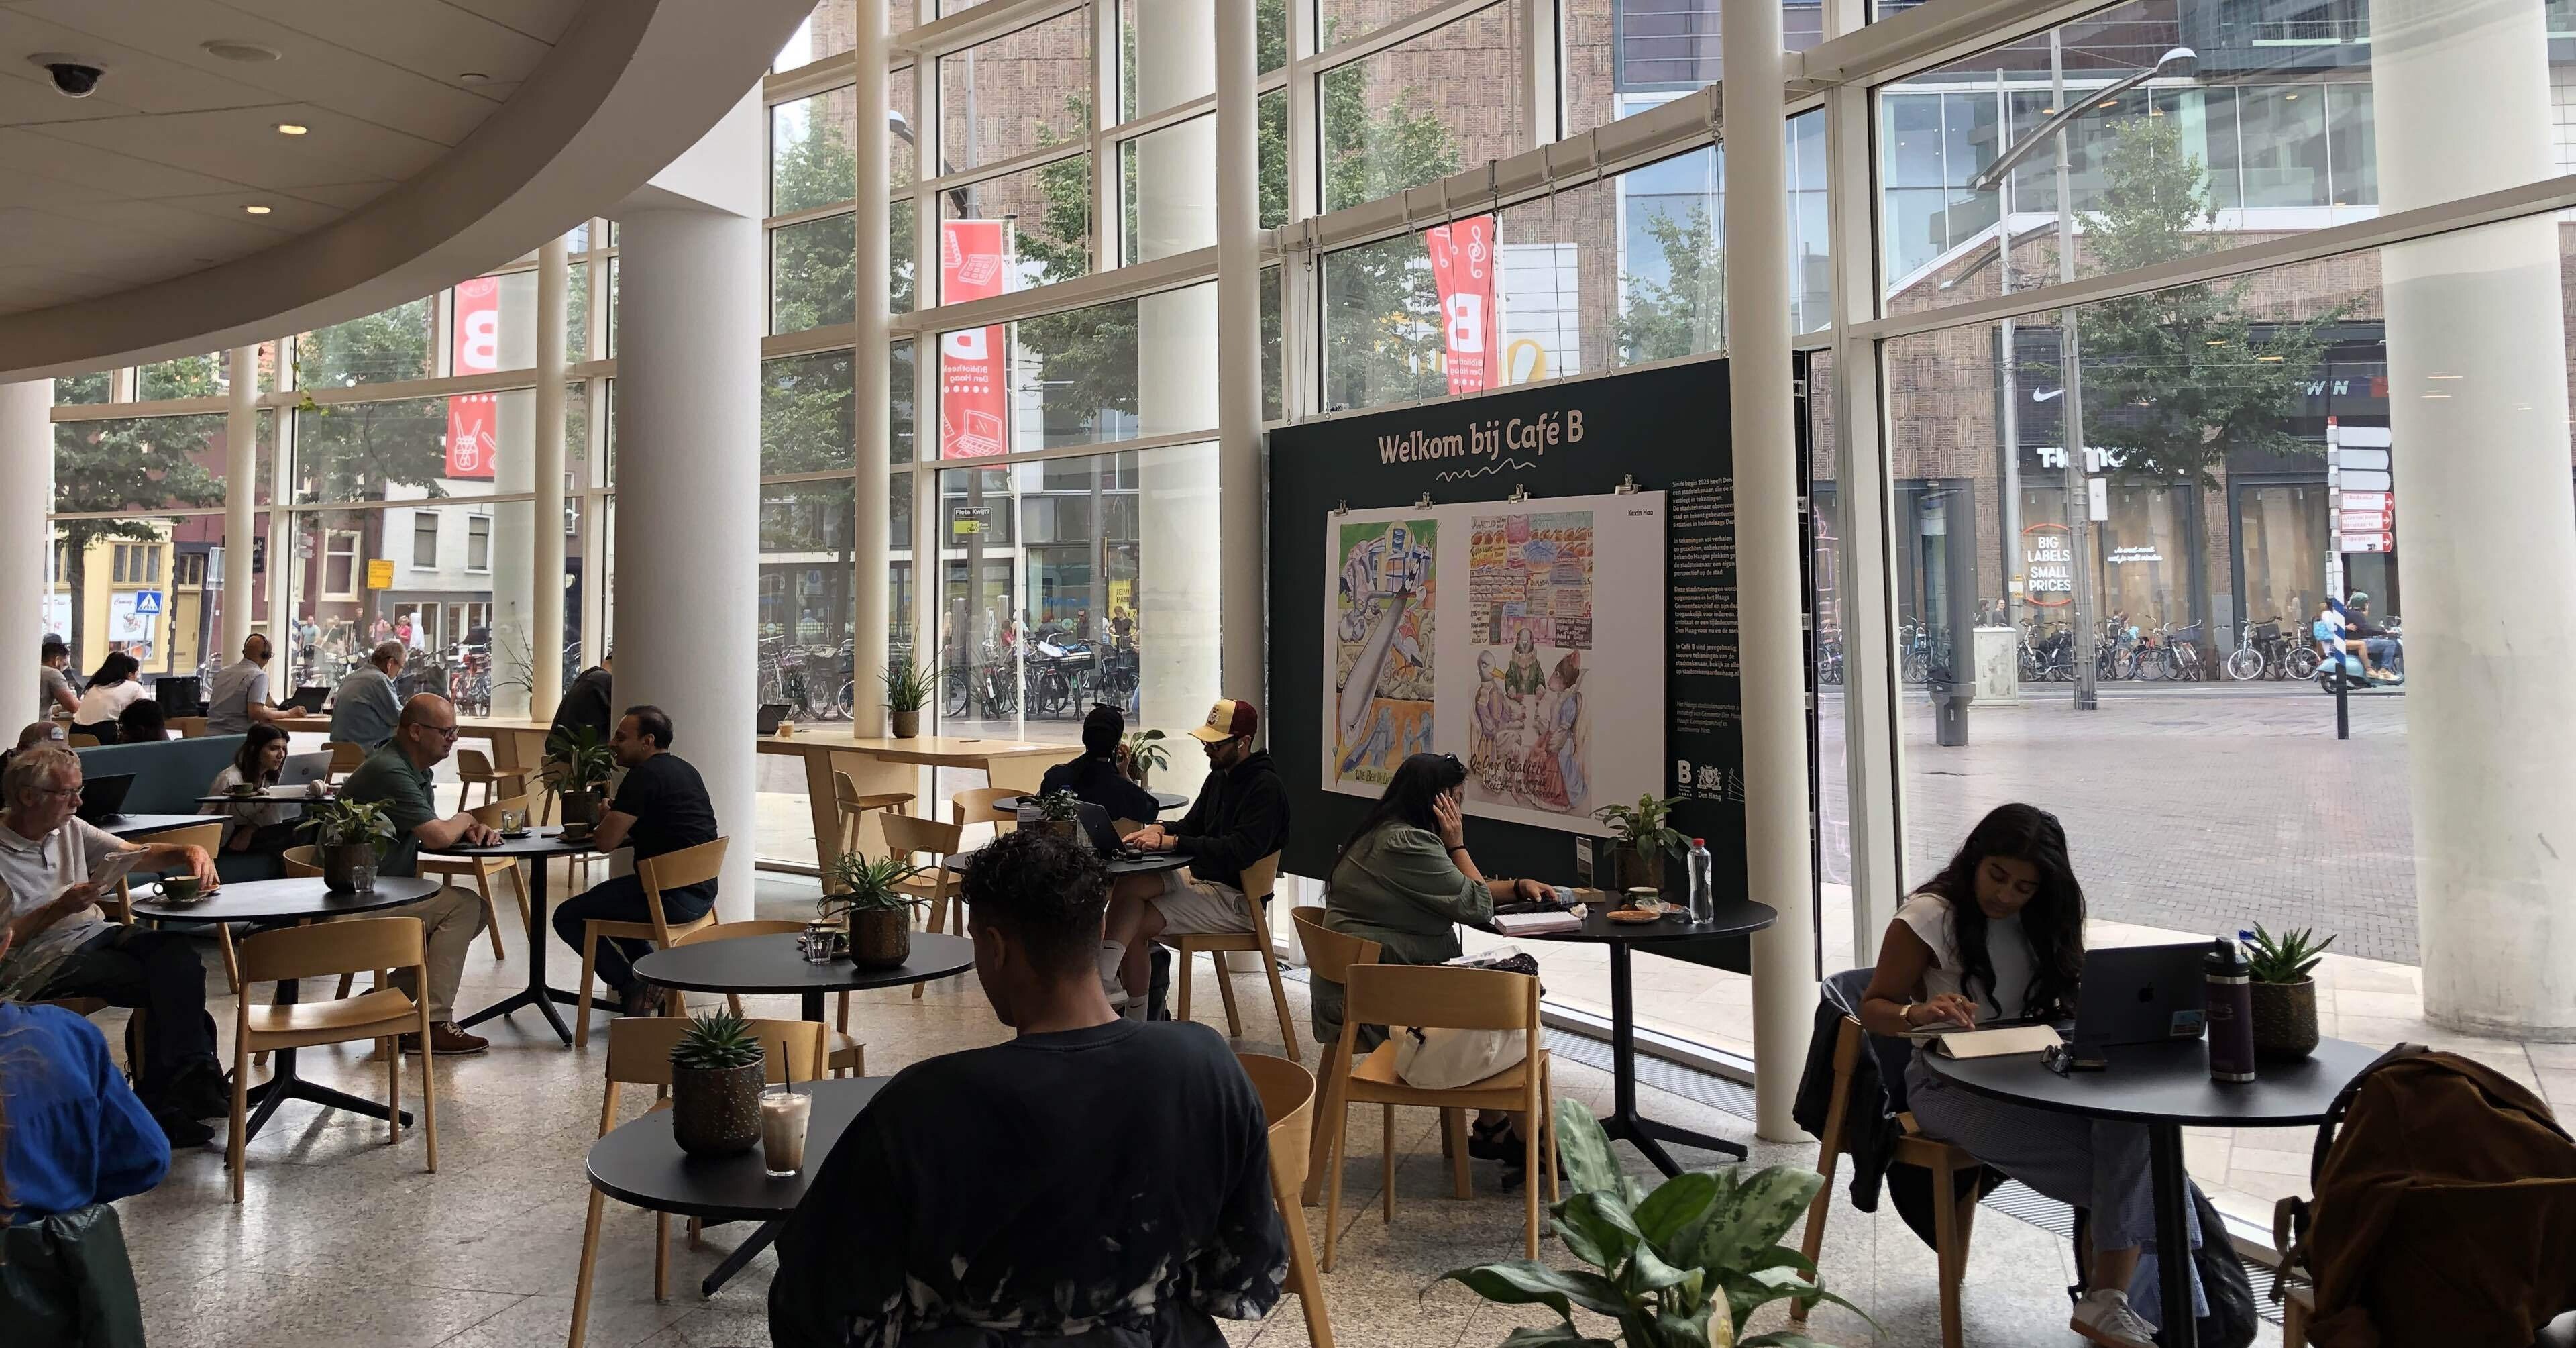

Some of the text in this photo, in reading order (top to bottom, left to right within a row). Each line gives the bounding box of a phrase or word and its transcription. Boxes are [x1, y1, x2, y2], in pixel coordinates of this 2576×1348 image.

[1378, 409, 1585, 464] Welkom bij Café B
[2038, 536, 2059, 548] BIG
[2027, 549, 2070, 562] LABELS
[1674, 569, 1699, 577] perspectief
[2030, 566, 2070, 578] SMALL
[2029, 578, 2072, 592] PRICES
[1678, 760, 1691, 784] B
[1698, 791, 1721, 802] Den Haag
